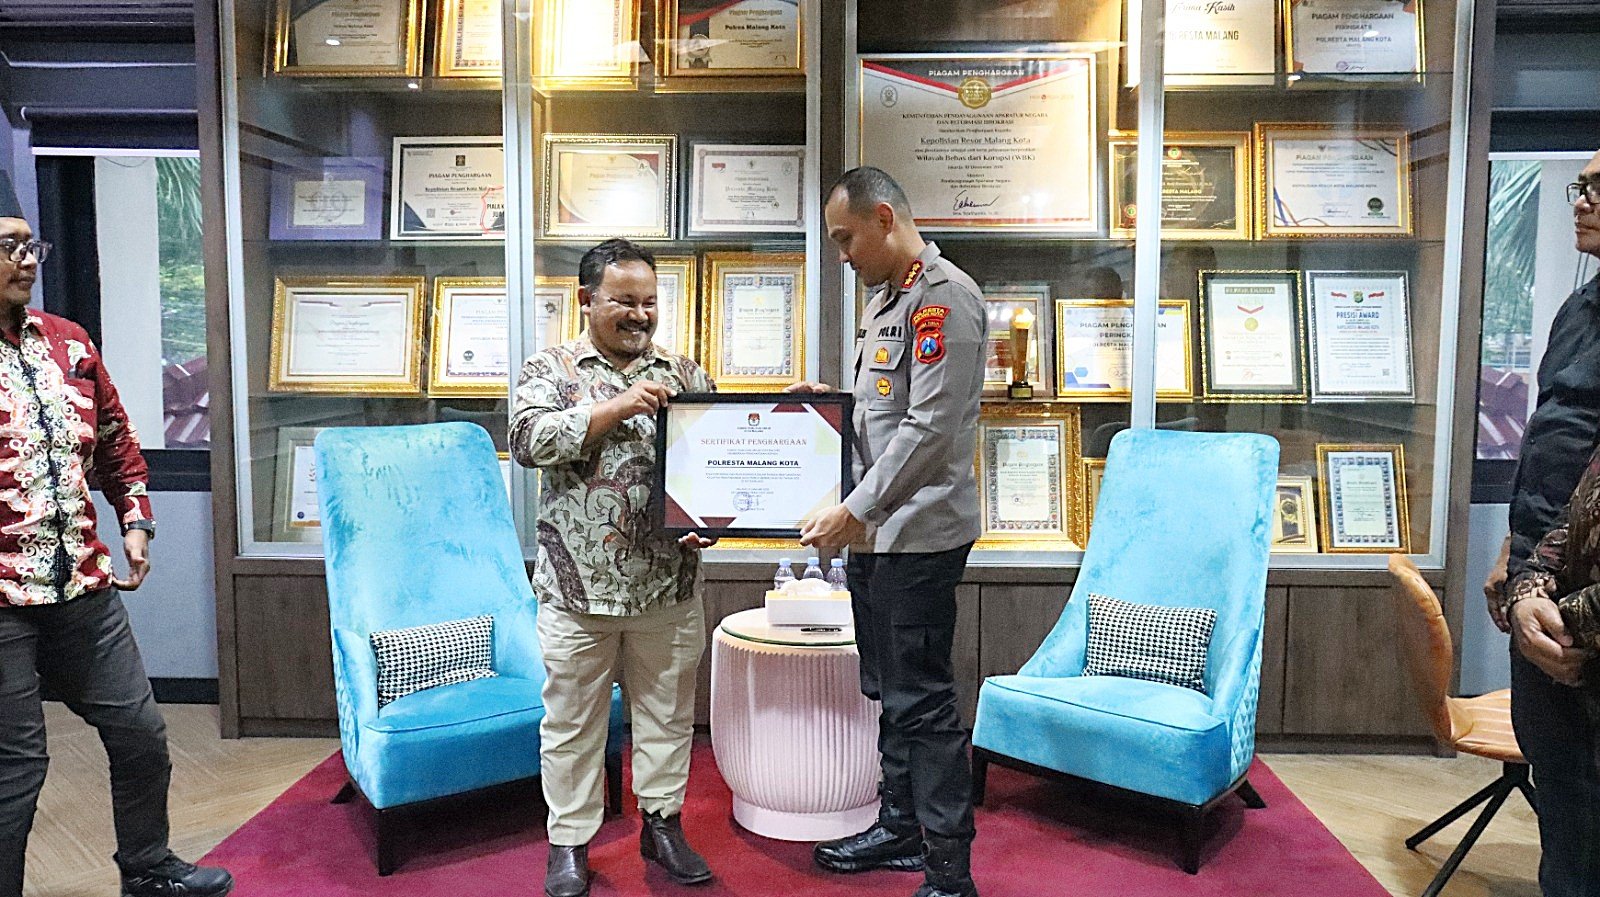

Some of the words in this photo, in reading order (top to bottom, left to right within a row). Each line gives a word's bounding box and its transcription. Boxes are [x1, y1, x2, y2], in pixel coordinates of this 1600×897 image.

[1204, 1, 1235, 14] Kasih
[1206, 31, 1239, 40] MALANG
[984, 137, 1012, 146] Malang
[700, 438, 745, 446] SERTIFIKAT
